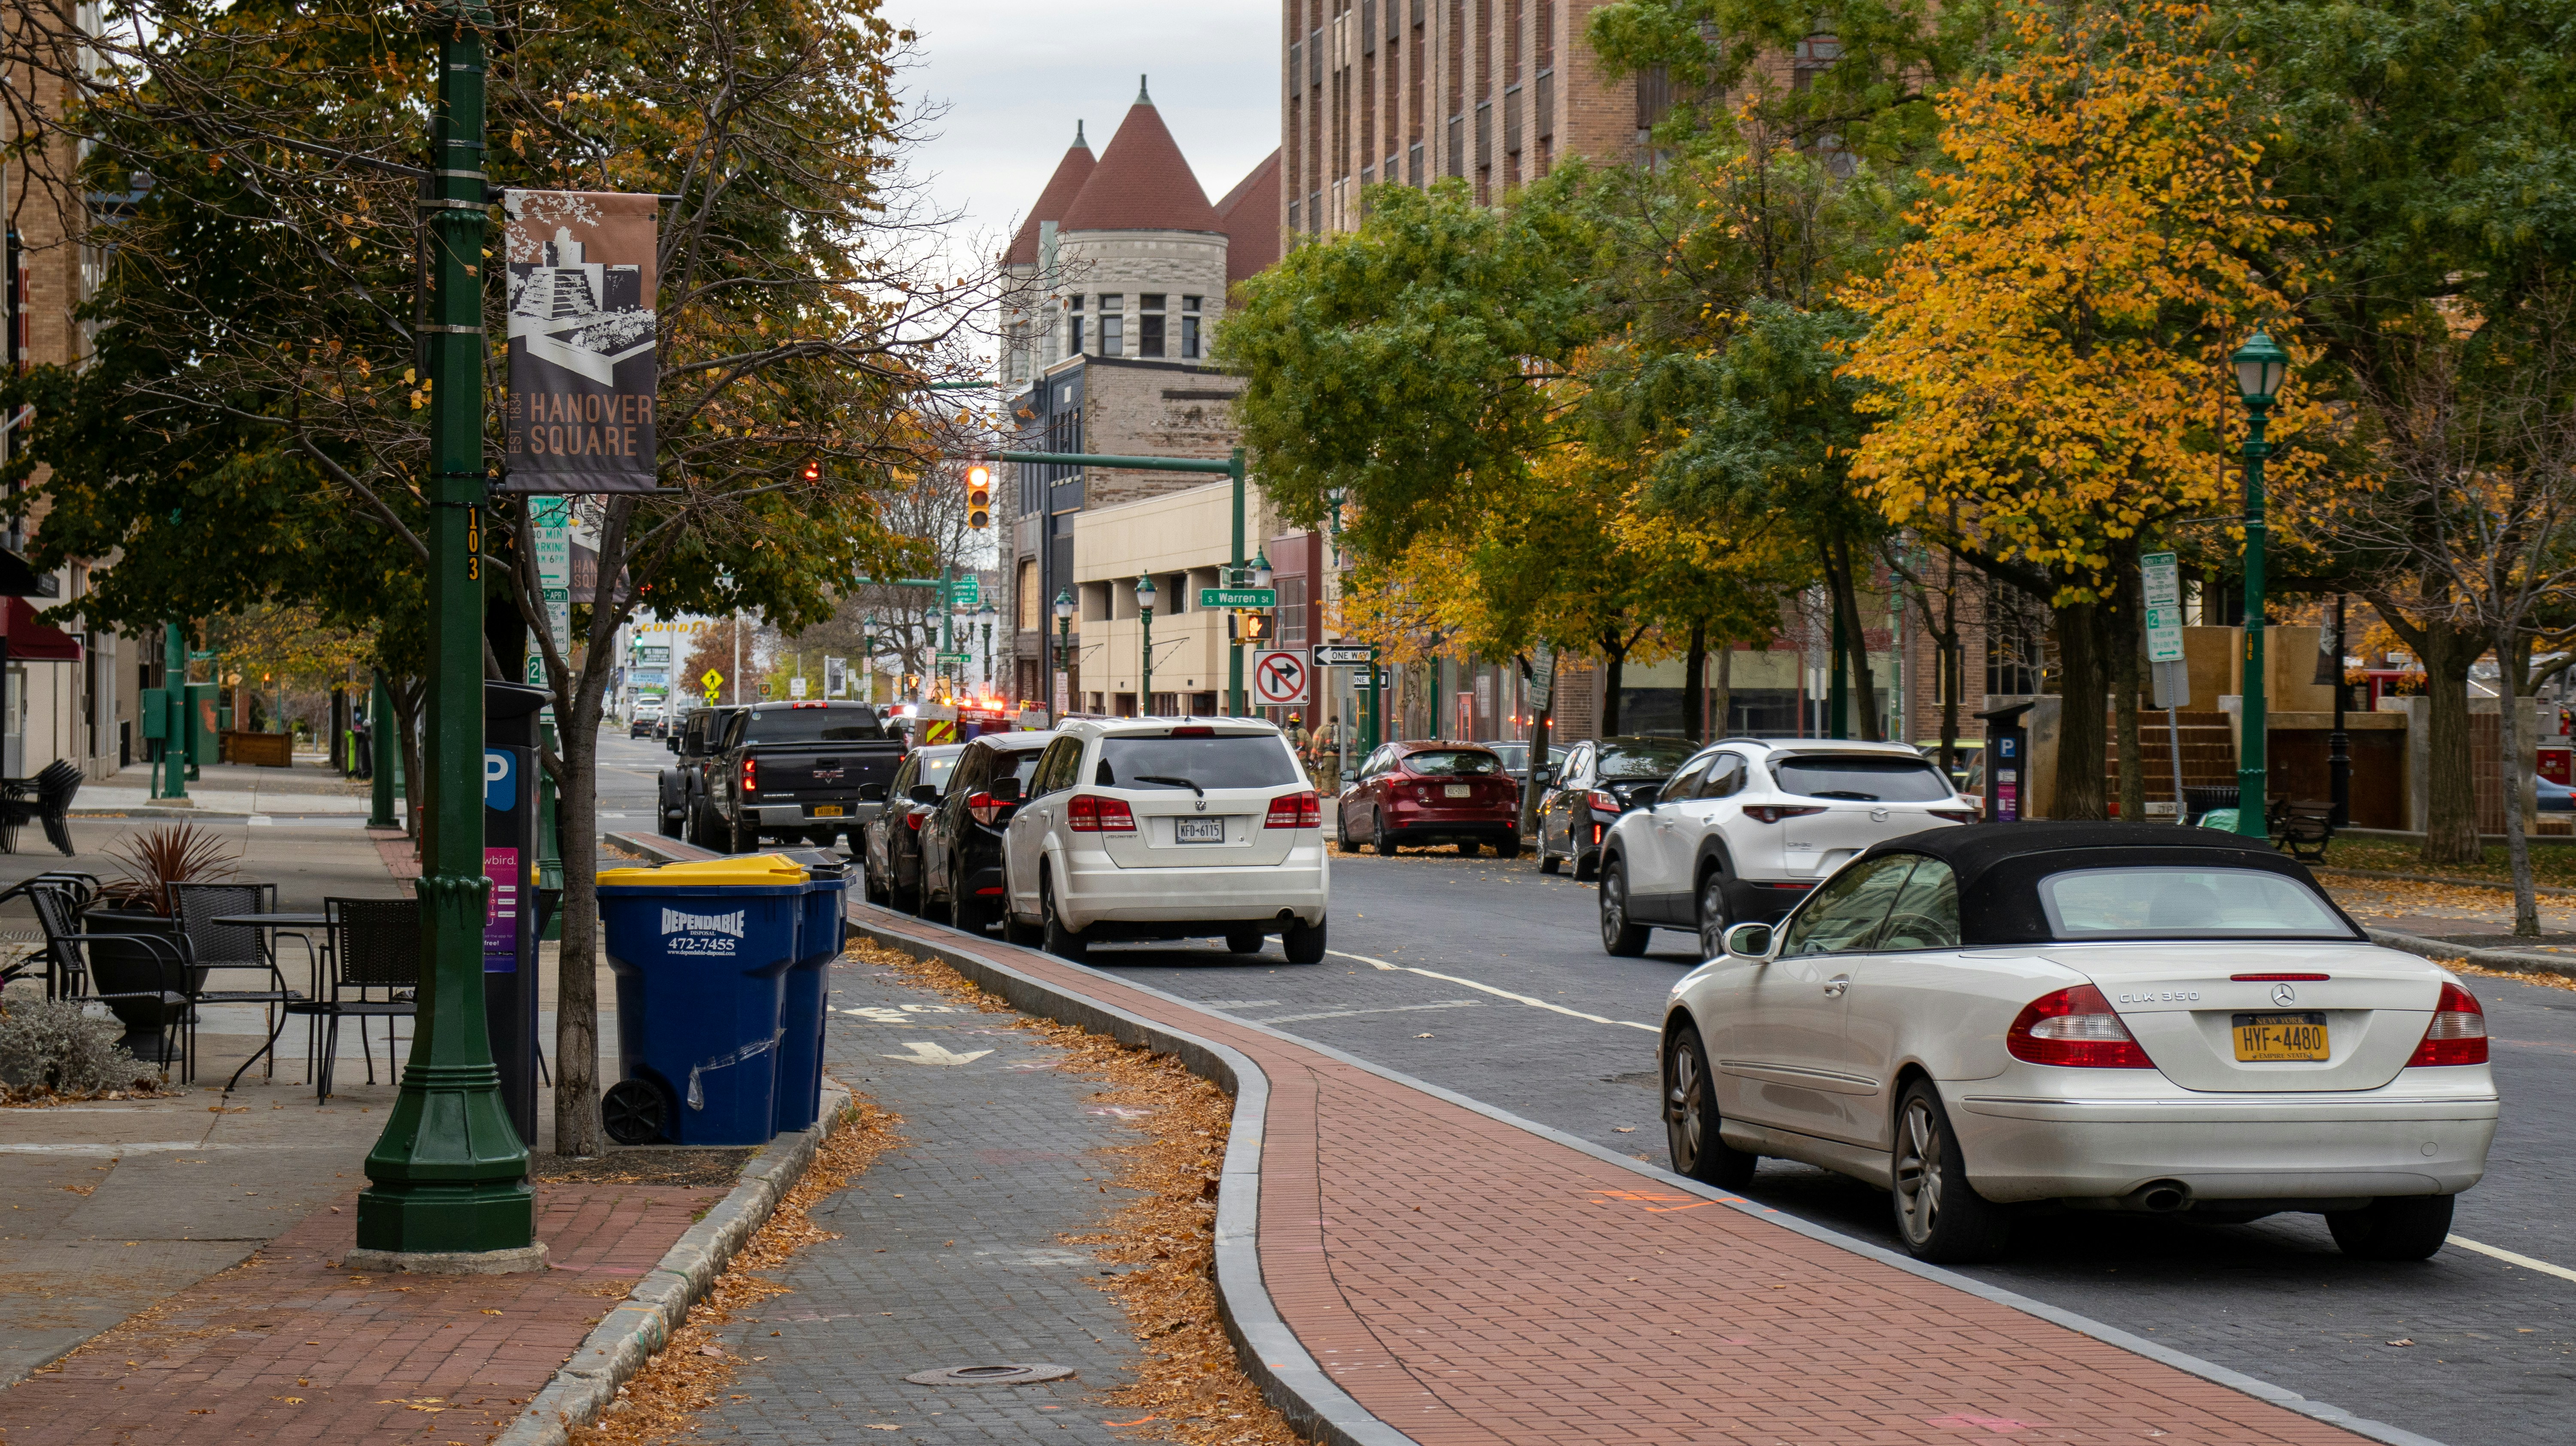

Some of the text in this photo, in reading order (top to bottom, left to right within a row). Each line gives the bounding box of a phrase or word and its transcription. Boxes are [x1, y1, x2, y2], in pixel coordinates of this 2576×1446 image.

[530, 392, 653, 424] HANOVER
[508, 392, 522, 454] EST. 1834
[530, 425, 637, 456] SQUARE
[546, 529, 562, 539] MIN
[469, 507, 478, 580] 103
[536, 542, 565, 552] ARKING
[537, 555, 546, 563] AM
[550, 592, 562, 600] APR
[563, 592, 566, 600] 1
[1219, 592, 1256, 603] Warren
[2150, 613, 2158, 626] 2
[530, 662, 538, 678] 2
[2002, 739, 2014, 754] P
[485, 754, 509, 798] P
[813, 770, 844, 778] GMC
[485, 855, 516, 865] wbird.
[662, 907, 744, 939] DEPENDABLE
[668, 938, 735, 951] 472-7455
[2119, 991, 2199, 1003] CLK 350
